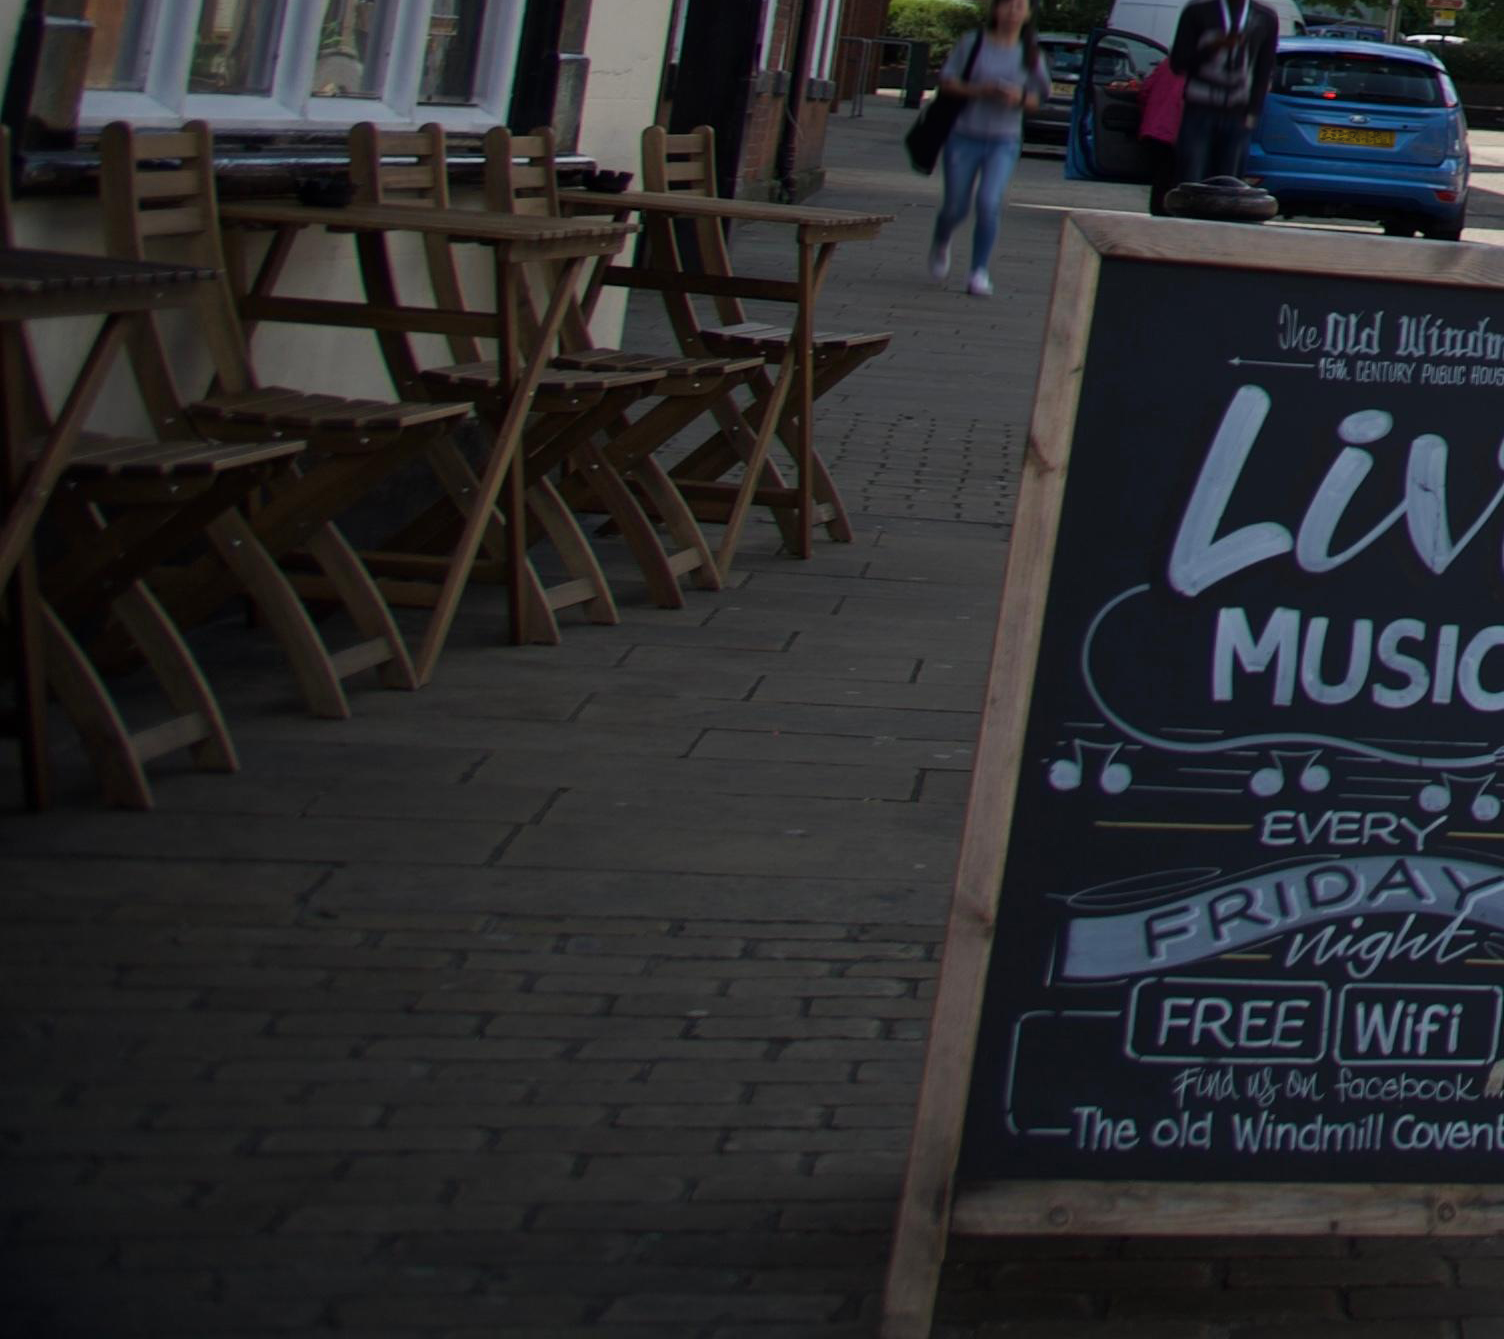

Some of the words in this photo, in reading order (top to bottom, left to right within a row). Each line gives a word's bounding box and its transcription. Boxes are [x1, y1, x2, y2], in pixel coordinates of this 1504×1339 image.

[1276, 303, 1322, 352] The
[1322, 310, 1384, 356] Old
[1355, 360, 1416, 385] CENTURY
[1420, 363, 1467, 386] PUBLIC
[1260, 809, 1449, 851] EVERY
[1284, 913, 1482, 980] night
[1156, 996, 1313, 1050] FREE
[1354, 1000, 1466, 1056] Wifi
[1172, 1066, 1241, 1108] Find
[1244, 1067, 1283, 1107] us
[1285, 1067, 1327, 1102] on
[1071, 1105, 1141, 1152] The
[1150, 1110, 1213, 1150] old
[1231, 1110, 1385, 1155] Windmill
